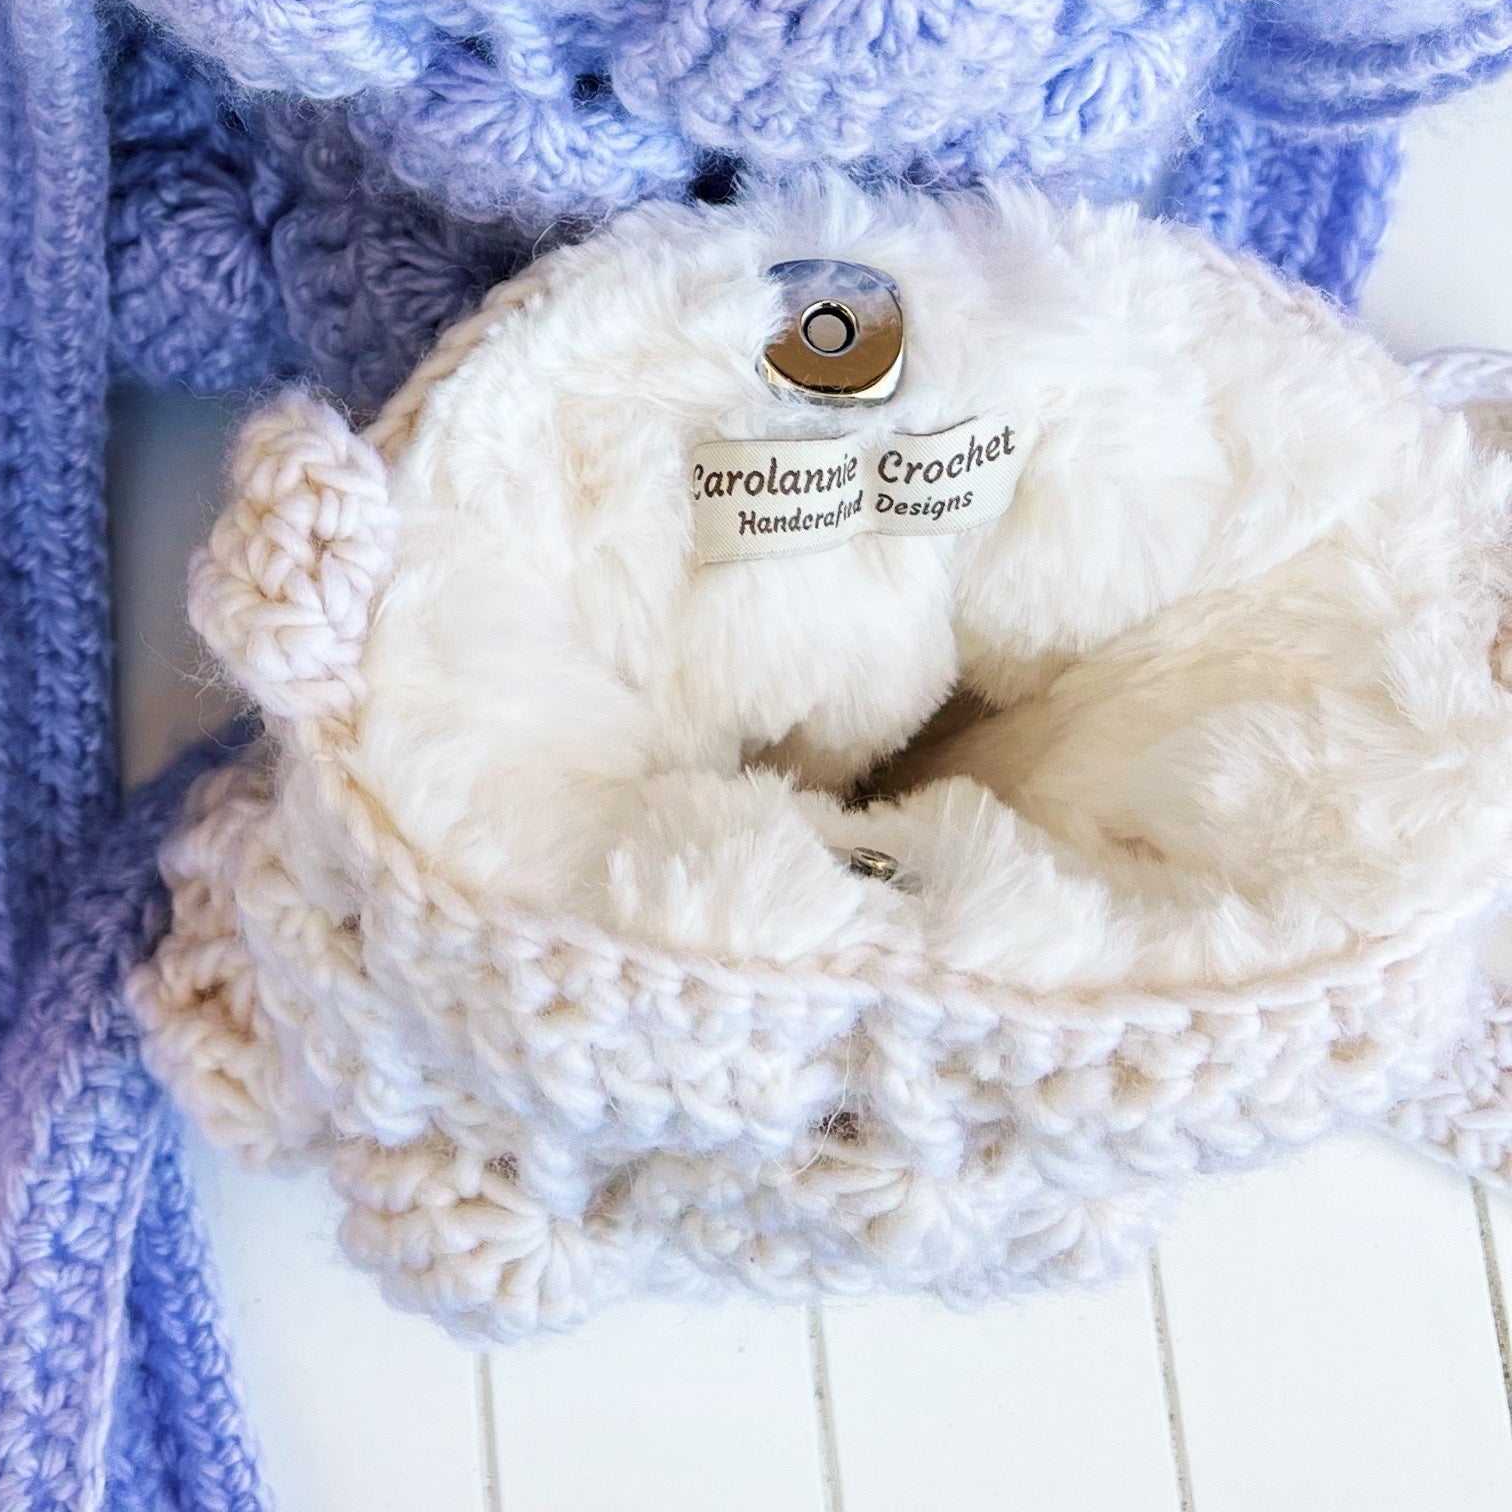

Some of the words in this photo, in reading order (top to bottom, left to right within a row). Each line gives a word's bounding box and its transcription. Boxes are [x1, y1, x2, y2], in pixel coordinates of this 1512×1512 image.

[692, 453, 858, 501] Carolannie
[877, 425, 1016, 485] Crochet
[875, 490, 974, 521] Designs
